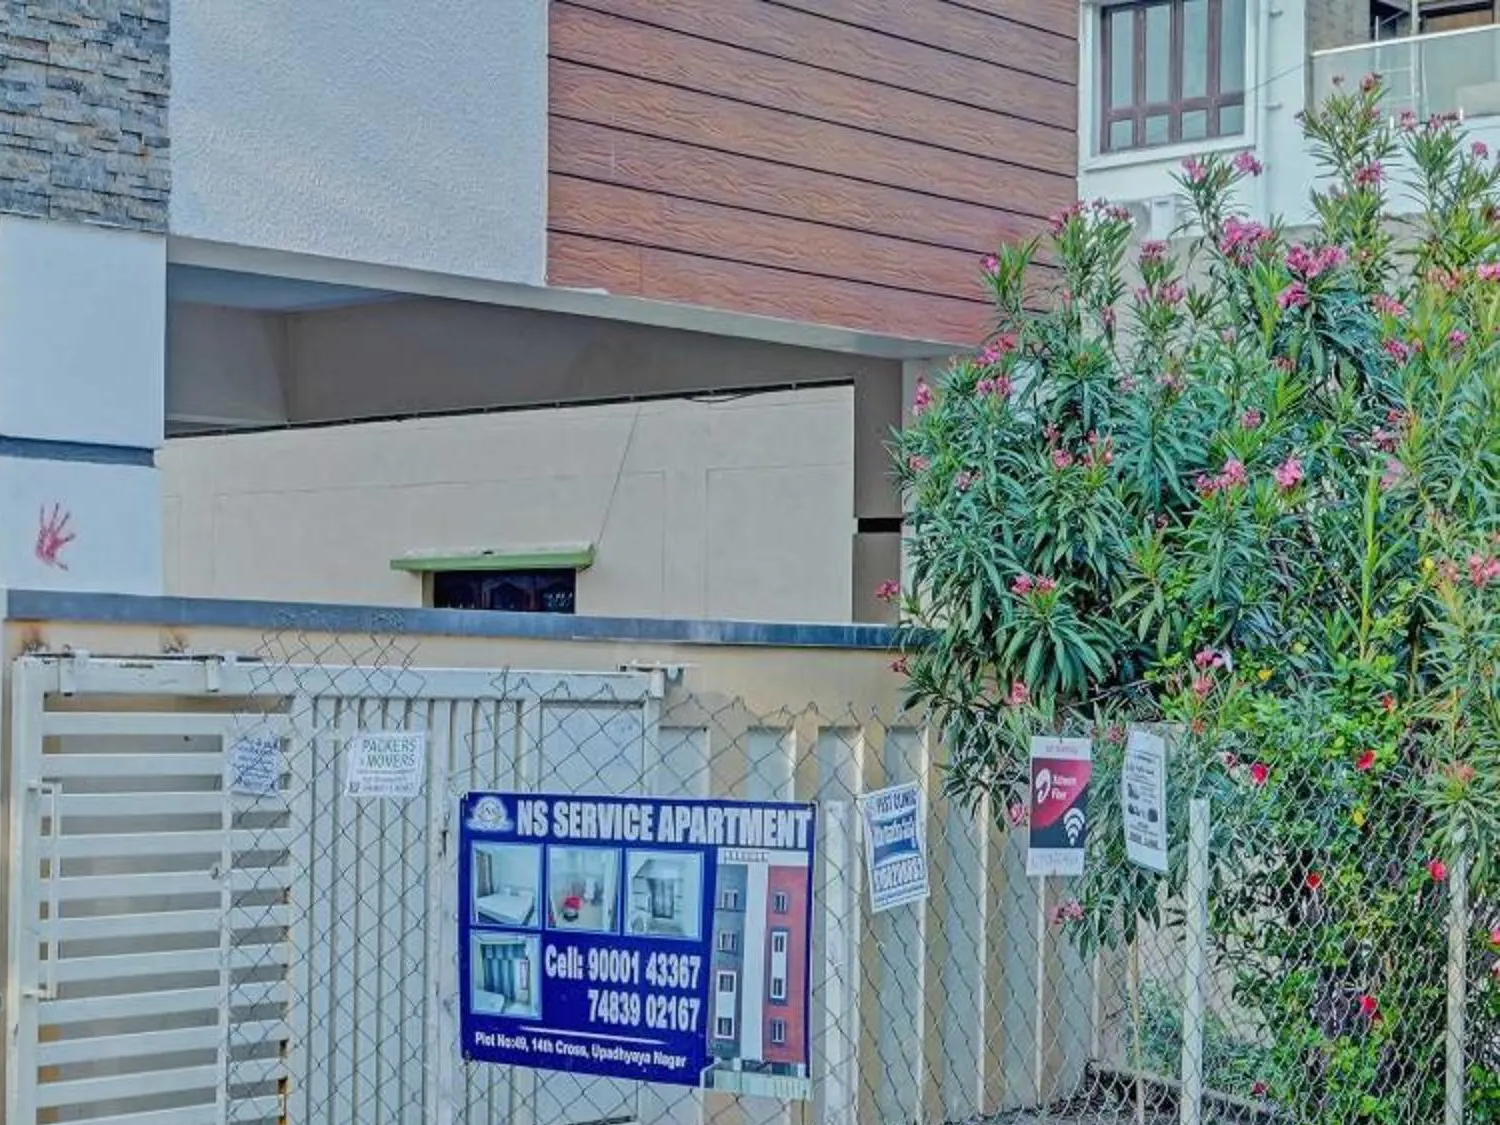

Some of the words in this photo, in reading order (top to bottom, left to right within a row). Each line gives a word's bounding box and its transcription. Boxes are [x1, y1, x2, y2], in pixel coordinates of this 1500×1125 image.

[517, 800, 548, 836] NS
[553, 802, 653, 842] SERVICE
[657, 805, 813, 849] APARTMENT
[545, 943, 584, 980] Cell:
[588, 948, 640, 985] 90001
[645, 952, 701, 989] 43367
[587, 989, 641, 1027] 74839
[645, 993, 701, 1032] 02167
[475, 1031, 496, 1047] Plot
[653, 1050, 687, 1070] Nagar
